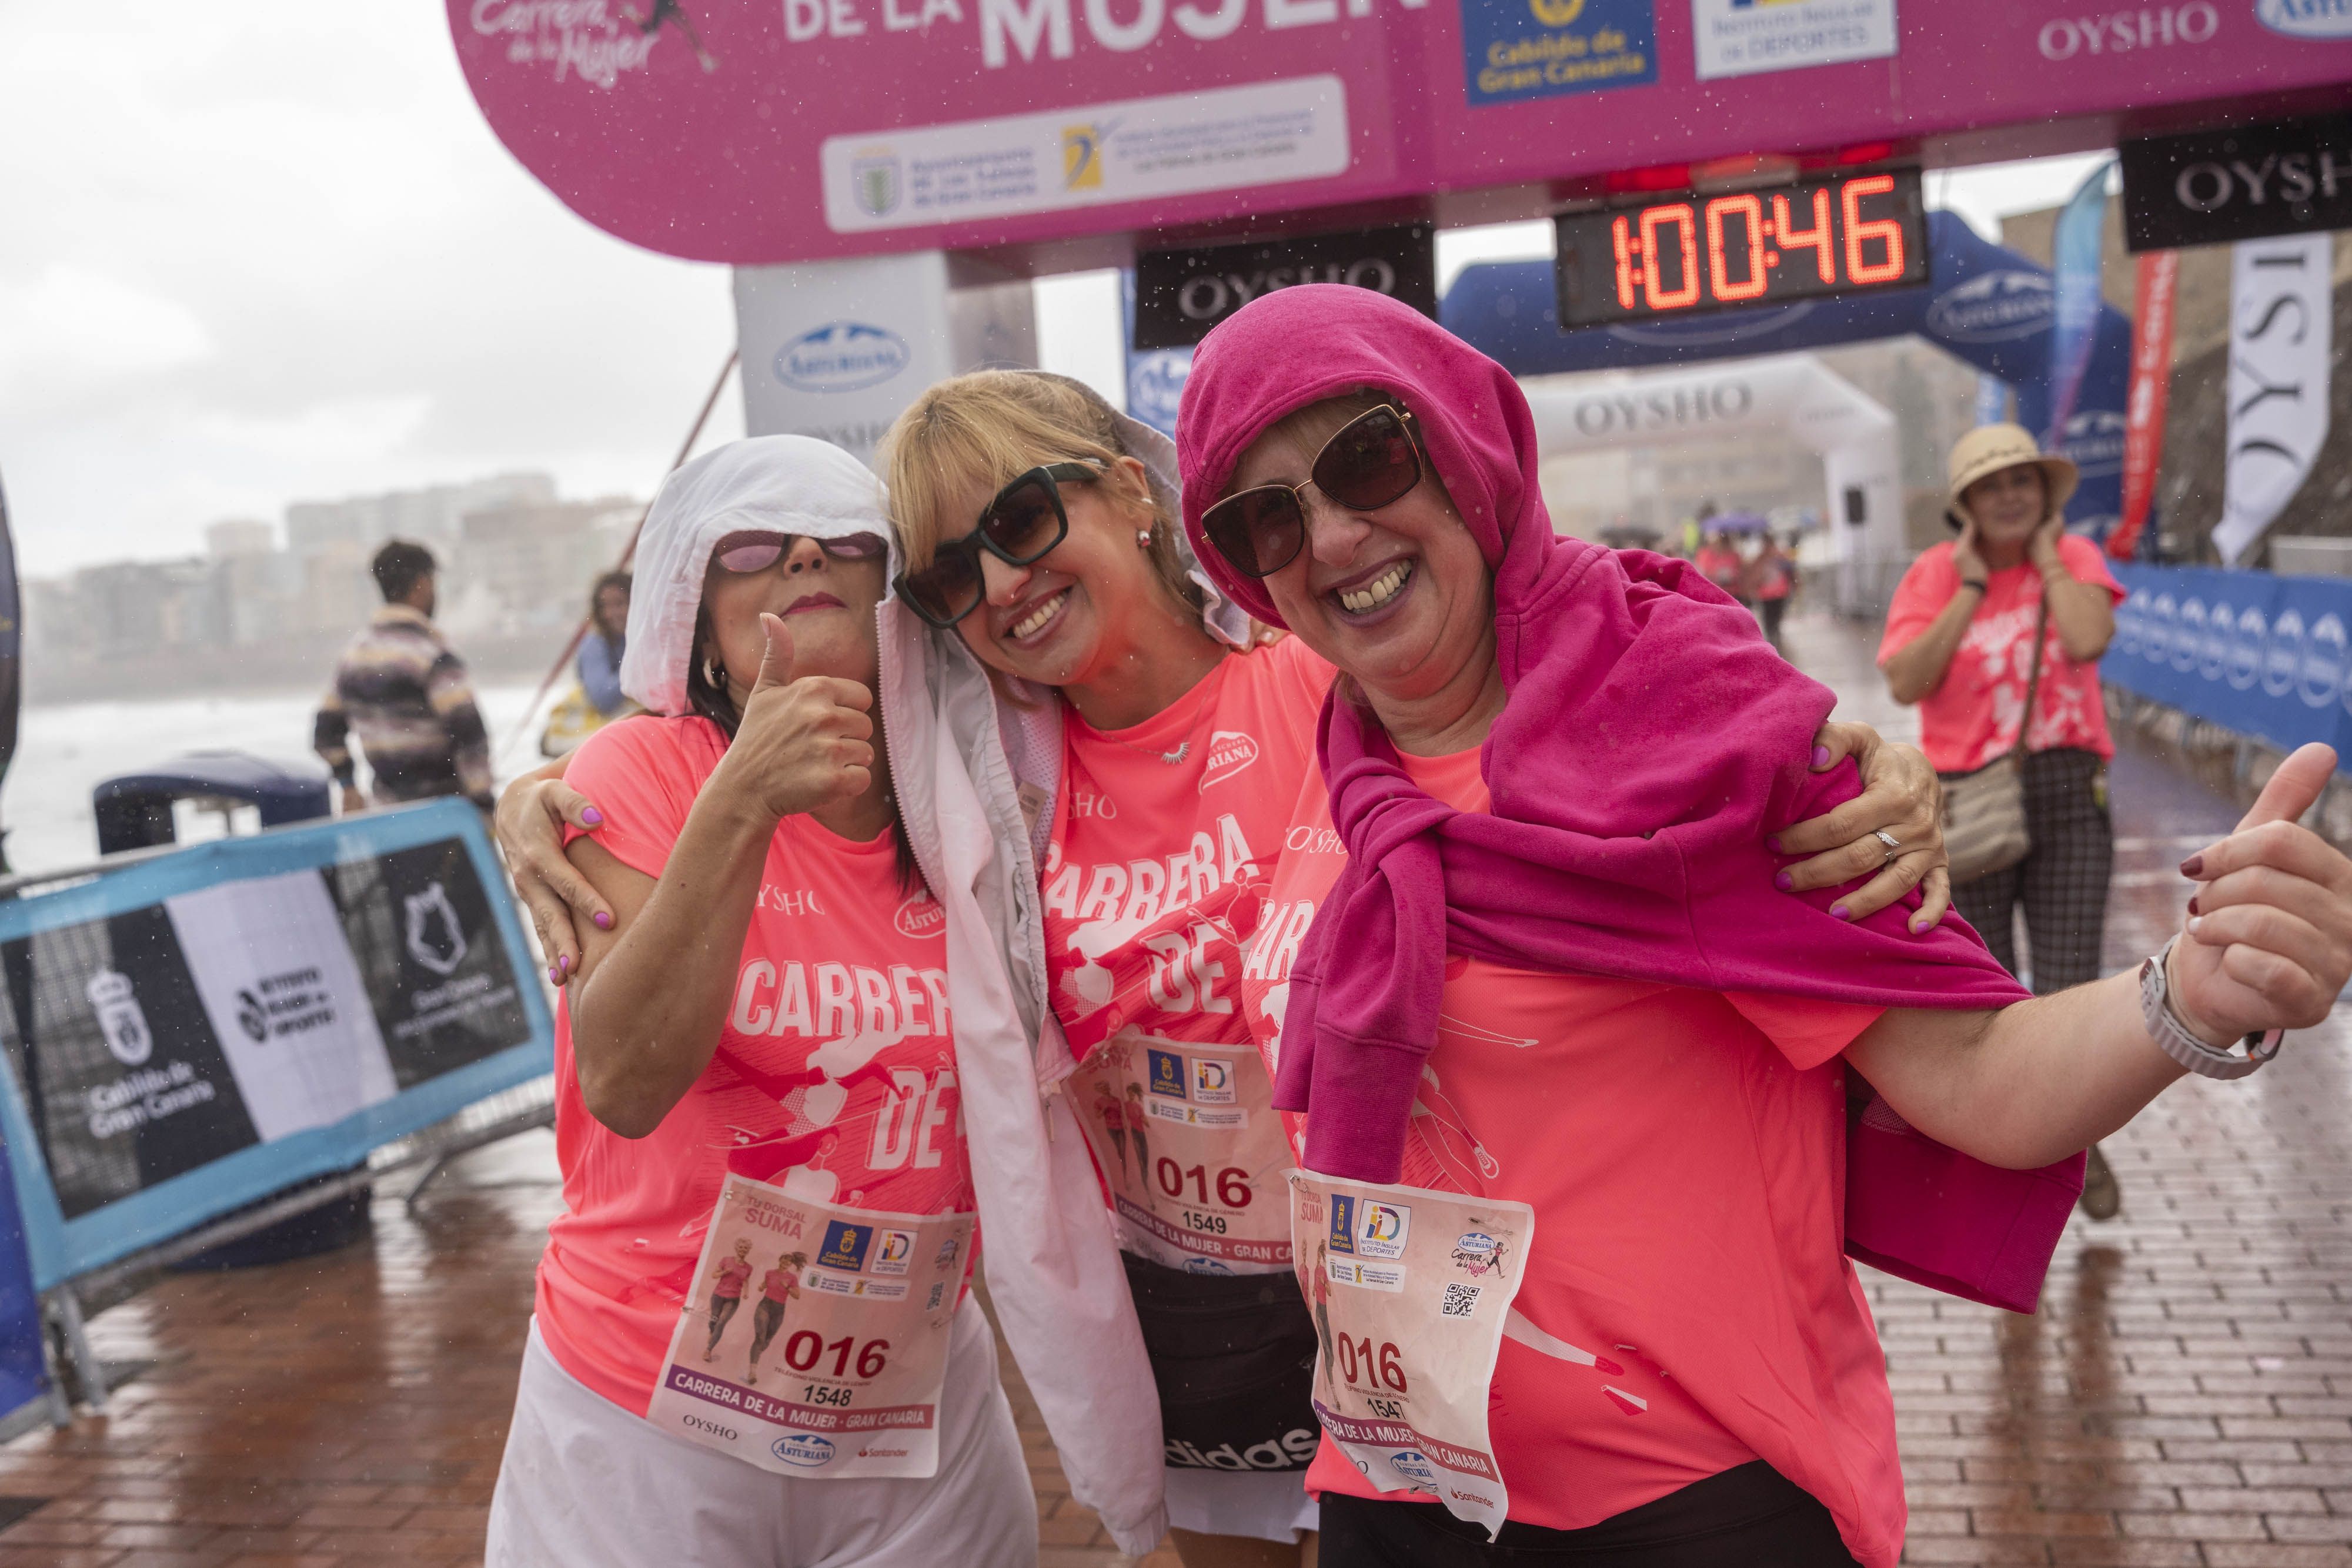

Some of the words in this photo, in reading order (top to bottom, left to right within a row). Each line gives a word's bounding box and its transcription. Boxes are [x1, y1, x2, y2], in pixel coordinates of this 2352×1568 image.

[786, 0, 866, 42] DE
[2038, 1, 2219, 60] OYSHO
[1488, 31, 1589, 68] Cabildo
[1592, 28, 1627, 54] de
[1477, 61, 1541, 93] Gran
[1544, 51, 1645, 85] Canaria
[1612, 175, 1905, 310] 1:00:46
[1575, 377, 1753, 437] OYSHO
[1207, 744, 1253, 771] RIANA
[1044, 814, 1260, 920] CARRERA
[1140, 917, 1232, 1015] DE
[731, 957, 951, 1037] CARRER
[90, 1067, 170, 1111] Cabildo
[90, 1103, 146, 1139] Gran
[145, 1079, 216, 1119] Canaria
[865, 1065, 960, 1169] DE
[1157, 1156, 1252, 1208] 016
[744, 1207, 802, 1240] SUMA
[763, 1202, 806, 1223] DORSAL
[1183, 1211, 1227, 1234] 1549
[1301, 1202, 1324, 1224] SUMA
[1155, 1219, 1167, 1238] DE
[1167, 1227, 1181, 1243] LA
[1181, 1234, 1223, 1255] MUJER
[1234, 1245, 1271, 1260] GRAN
[1332, 1232, 1343, 1241] Cabildo
[1339, 1241, 1352, 1249] Canaria
[1360, 1238, 1381, 1247] INSTITUTO
[1381, 1241, 1400, 1250] INSULAR
[1367, 1246, 1395, 1255] DEPORTES
[1459, 1239, 1492, 1249] ASTURIANA
[1451, 1248, 1482, 1262] Carrera
[1464, 1261, 1492, 1278] Mujer
[785, 1330, 890, 1379] 016
[1338, 1332, 1408, 1394] 016
[675, 1373, 741, 1406] CARRERA
[744, 1395, 766, 1414] DE
[766, 1403, 785, 1420] LA
[789, 1409, 838, 1429] MUJER
[846, 1415, 874, 1429] GRAN
[877, 1410, 925, 1426] CANARIA
[804, 1385, 853, 1407] 1548
[1362, 1388, 1384, 1398] VIOLENCIA
[1367, 1398, 1406, 1420] 1547
[683, 1414, 739, 1440] OYSHO
[776, 1441, 831, 1460] ASTURIANA
[868, 1448, 908, 1457] Santander
[1165, 1429, 1319, 1470] didas
[1344, 1423, 1359, 1440] DE
[1359, 1426, 1377, 1441] LA
[1376, 1426, 1415, 1443] MUJER
[1416, 1437, 1441, 1461] GRAN
[1441, 1448, 1491, 1475] CANARIA
[1395, 1462, 1434, 1478] ASTURIA
[1457, 1491, 1495, 1509] Santander
